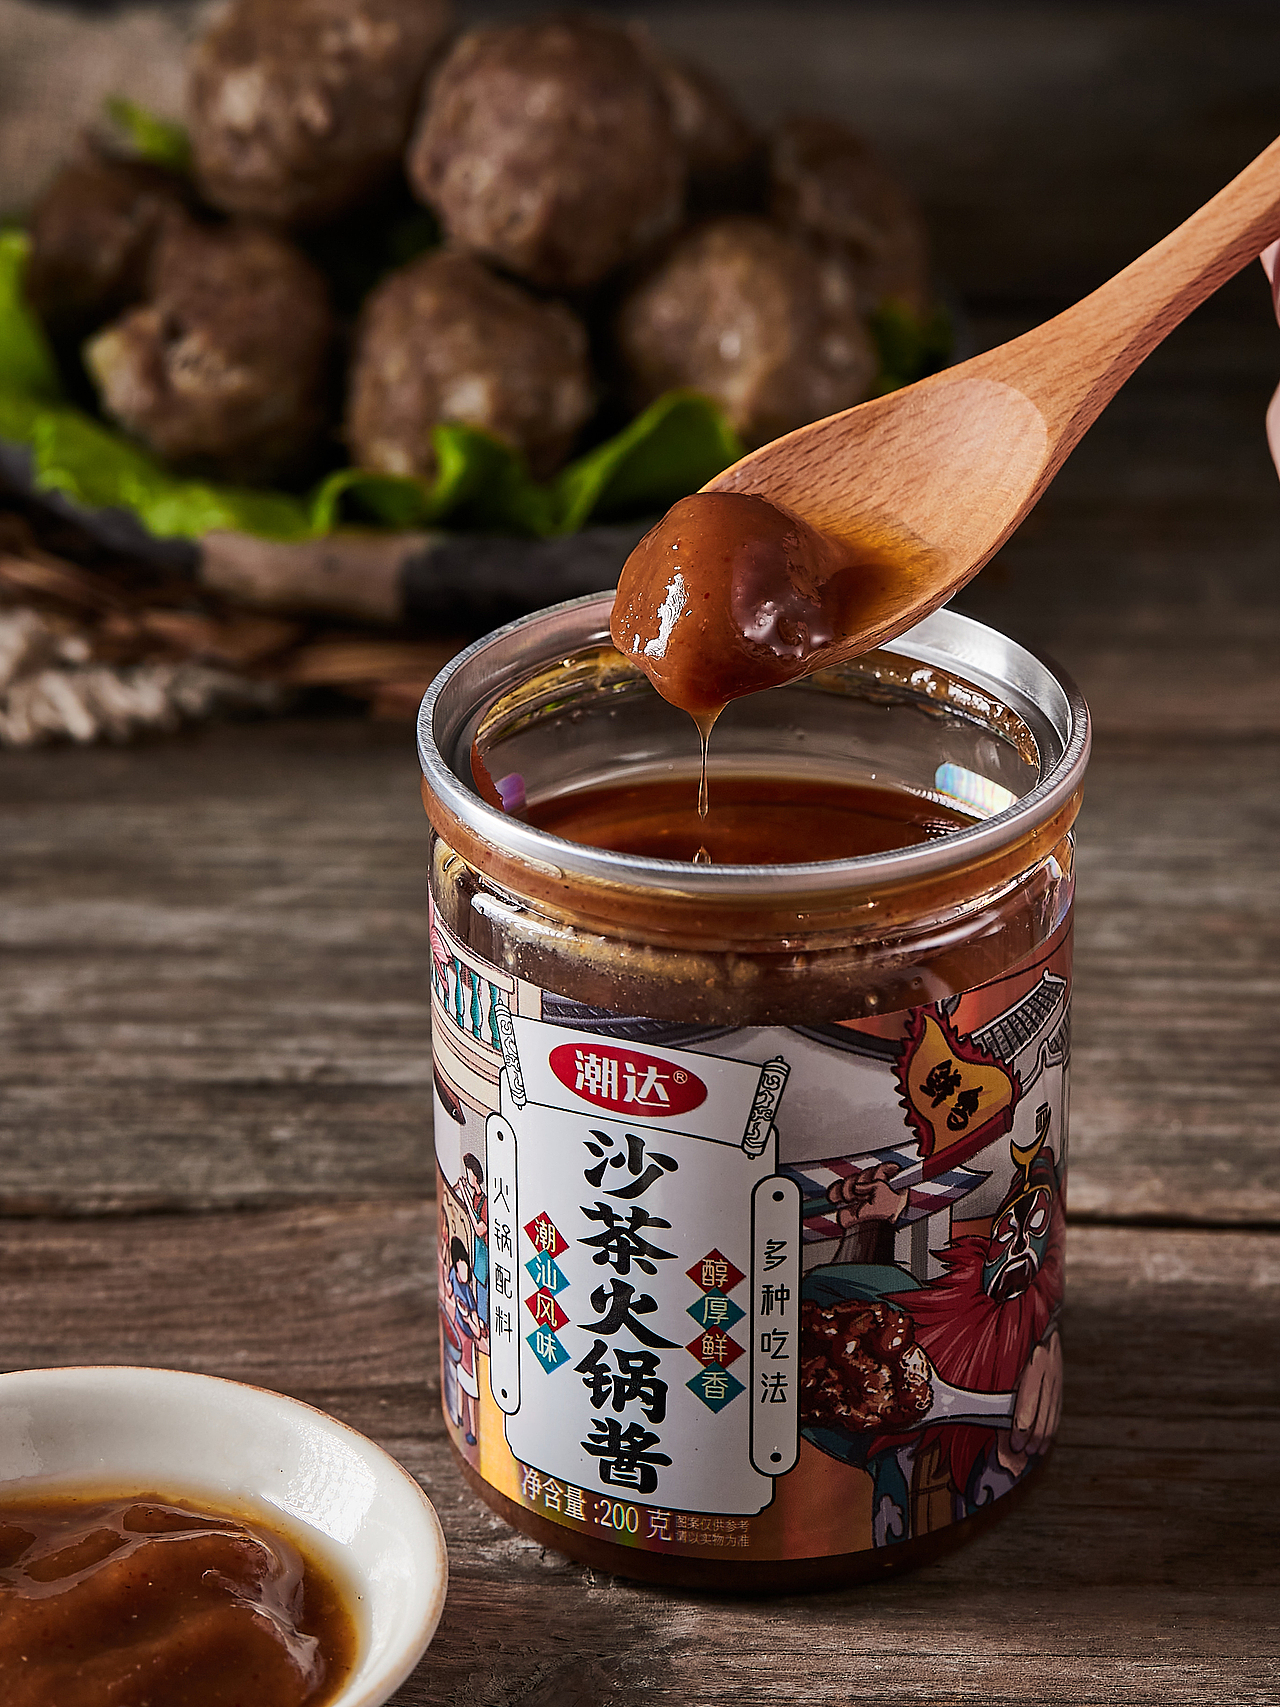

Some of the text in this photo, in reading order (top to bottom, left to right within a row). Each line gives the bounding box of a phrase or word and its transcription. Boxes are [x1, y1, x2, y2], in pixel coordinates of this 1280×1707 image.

[493, 1177, 513, 1343] 火锅配料
[534, 1217, 559, 1364] 潮汕风味
[573, 1129, 685, 1495] 沙茶火锅酱
[701, 1258, 730, 1400] 醇厚鲜香
[760, 1238, 791, 1404] 多种吃法
[675, 1514, 750, 1533] 图案仅供参考
[675, 1529, 750, 1548] 请以实物为准
